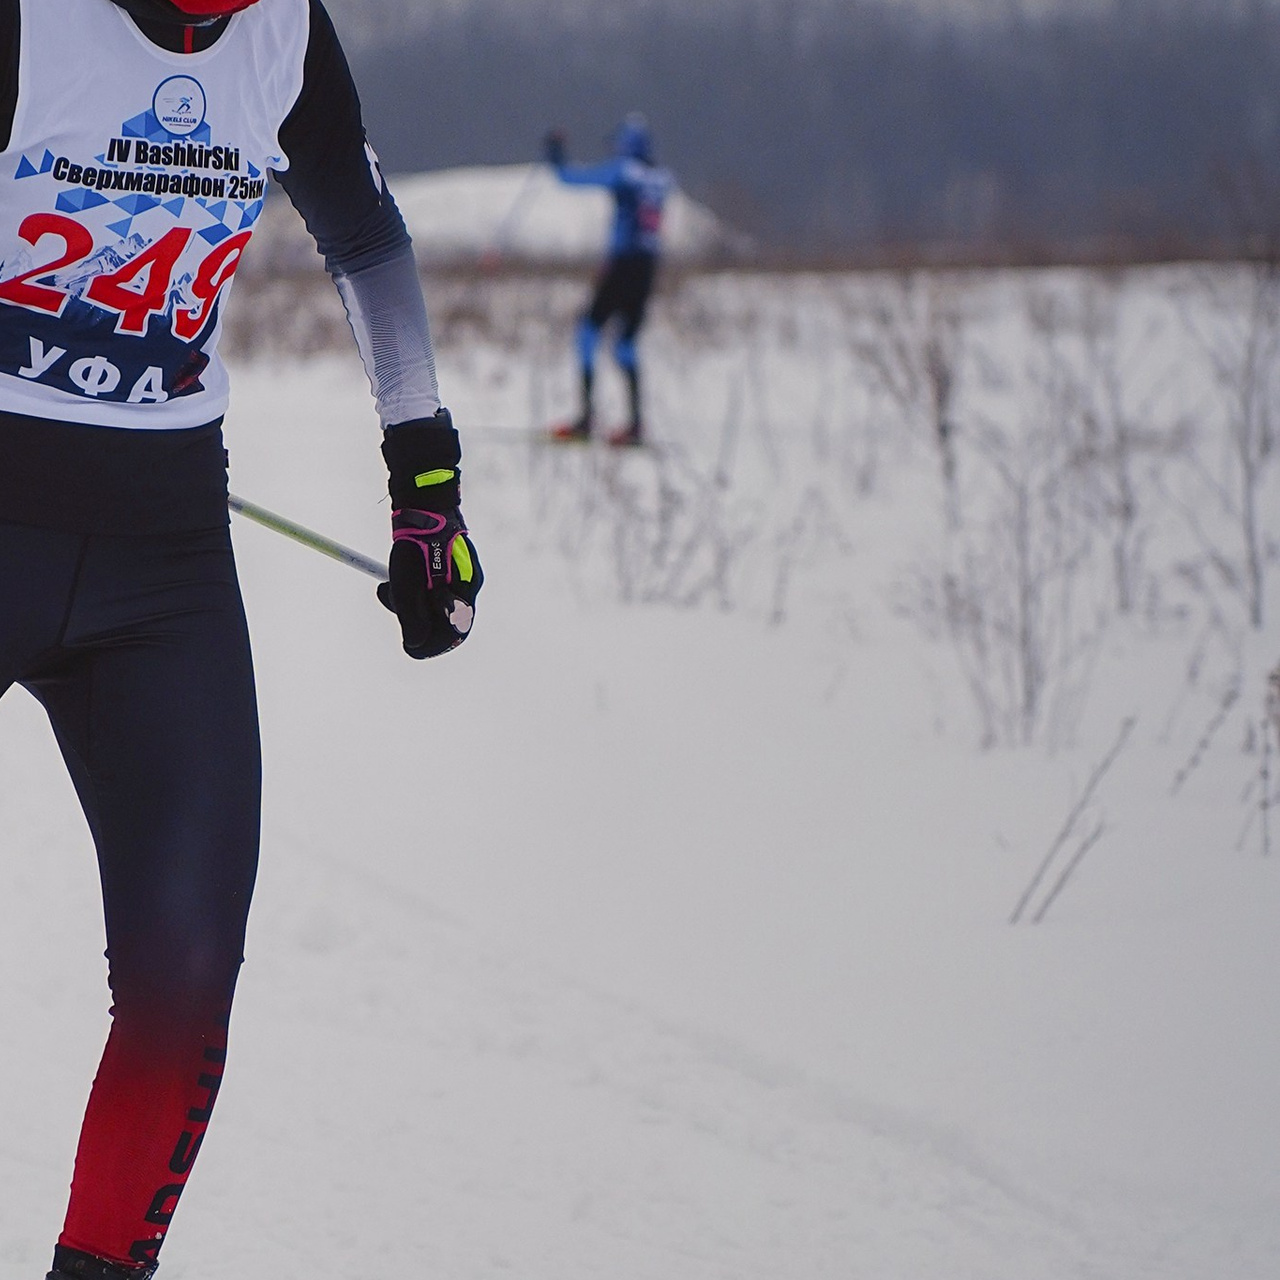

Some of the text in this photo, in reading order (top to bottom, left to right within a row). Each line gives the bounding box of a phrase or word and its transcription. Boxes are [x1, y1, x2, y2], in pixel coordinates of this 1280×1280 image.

[107, 138, 239, 172] IV BashkirSki
[52, 156, 225, 198] Сверхмарафон
[18, 335, 169, 404] УФА
